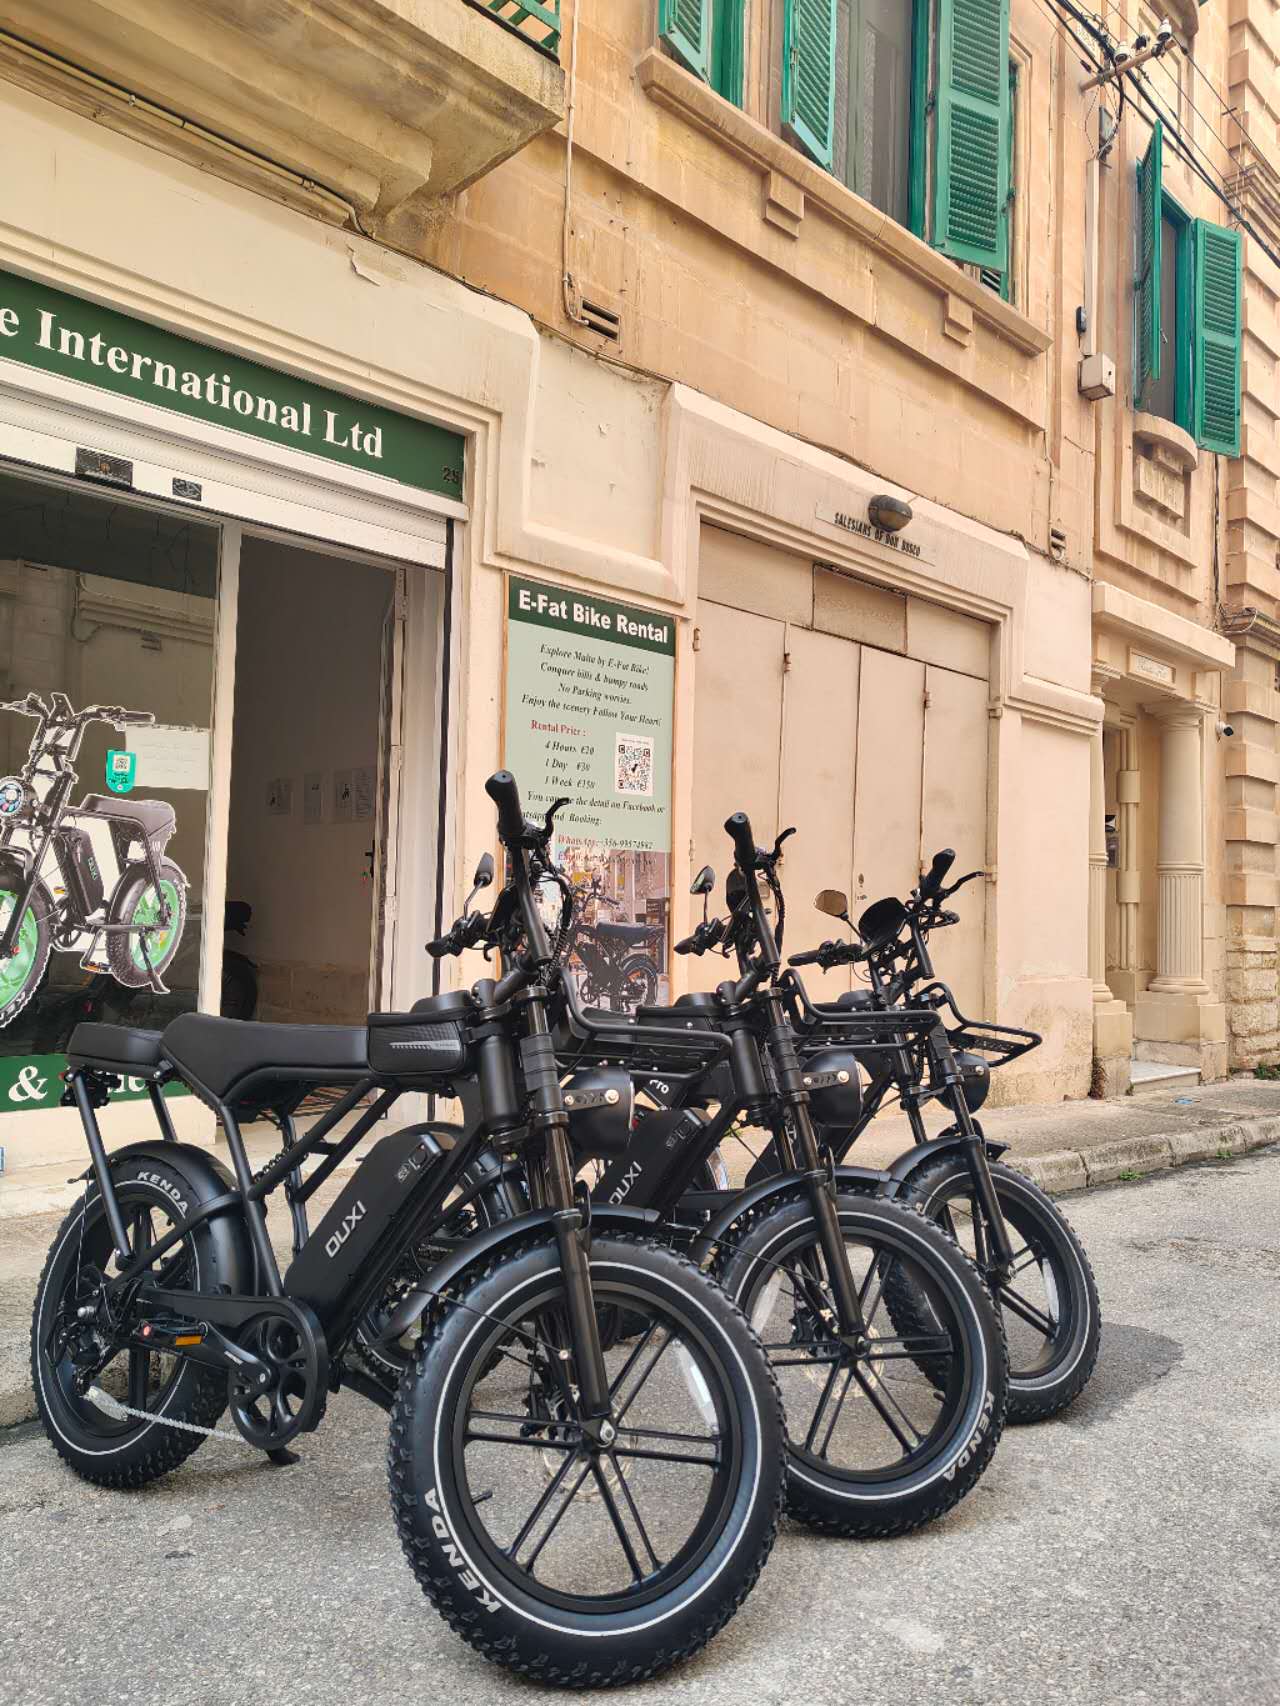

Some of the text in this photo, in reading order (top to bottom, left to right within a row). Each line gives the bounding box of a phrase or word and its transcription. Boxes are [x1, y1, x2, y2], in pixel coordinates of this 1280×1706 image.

[35, 308, 312, 436] International
[322, 409, 384, 459] Ltd
[834, 512, 871, 536] SALESIANS
[901, 539, 921, 557] BOSCO
[519, 590, 668, 643] E-Fat Bike Rental
[540, 643, 572, 660] Explore
[540, 661, 575, 677] Conquer
[595, 672, 602, 682] &
[521, 693, 546, 708] Enjoy
[548, 698, 561, 710] the
[558, 683, 571, 693] No
[572, 685, 602, 701] Parking
[530, 719, 558, 733] Rental
[552, 740, 577, 753] Hours
[552, 758, 568, 771] Day
[527, 790, 542, 802] You
[8, 1065, 48, 1102] &
[137, 1171, 188, 1214] KENDA
[325, 1200, 367, 1258] OUXI
[942, 1389, 995, 1481] KENDA
[424, 1487, 502, 1613] KENDA
